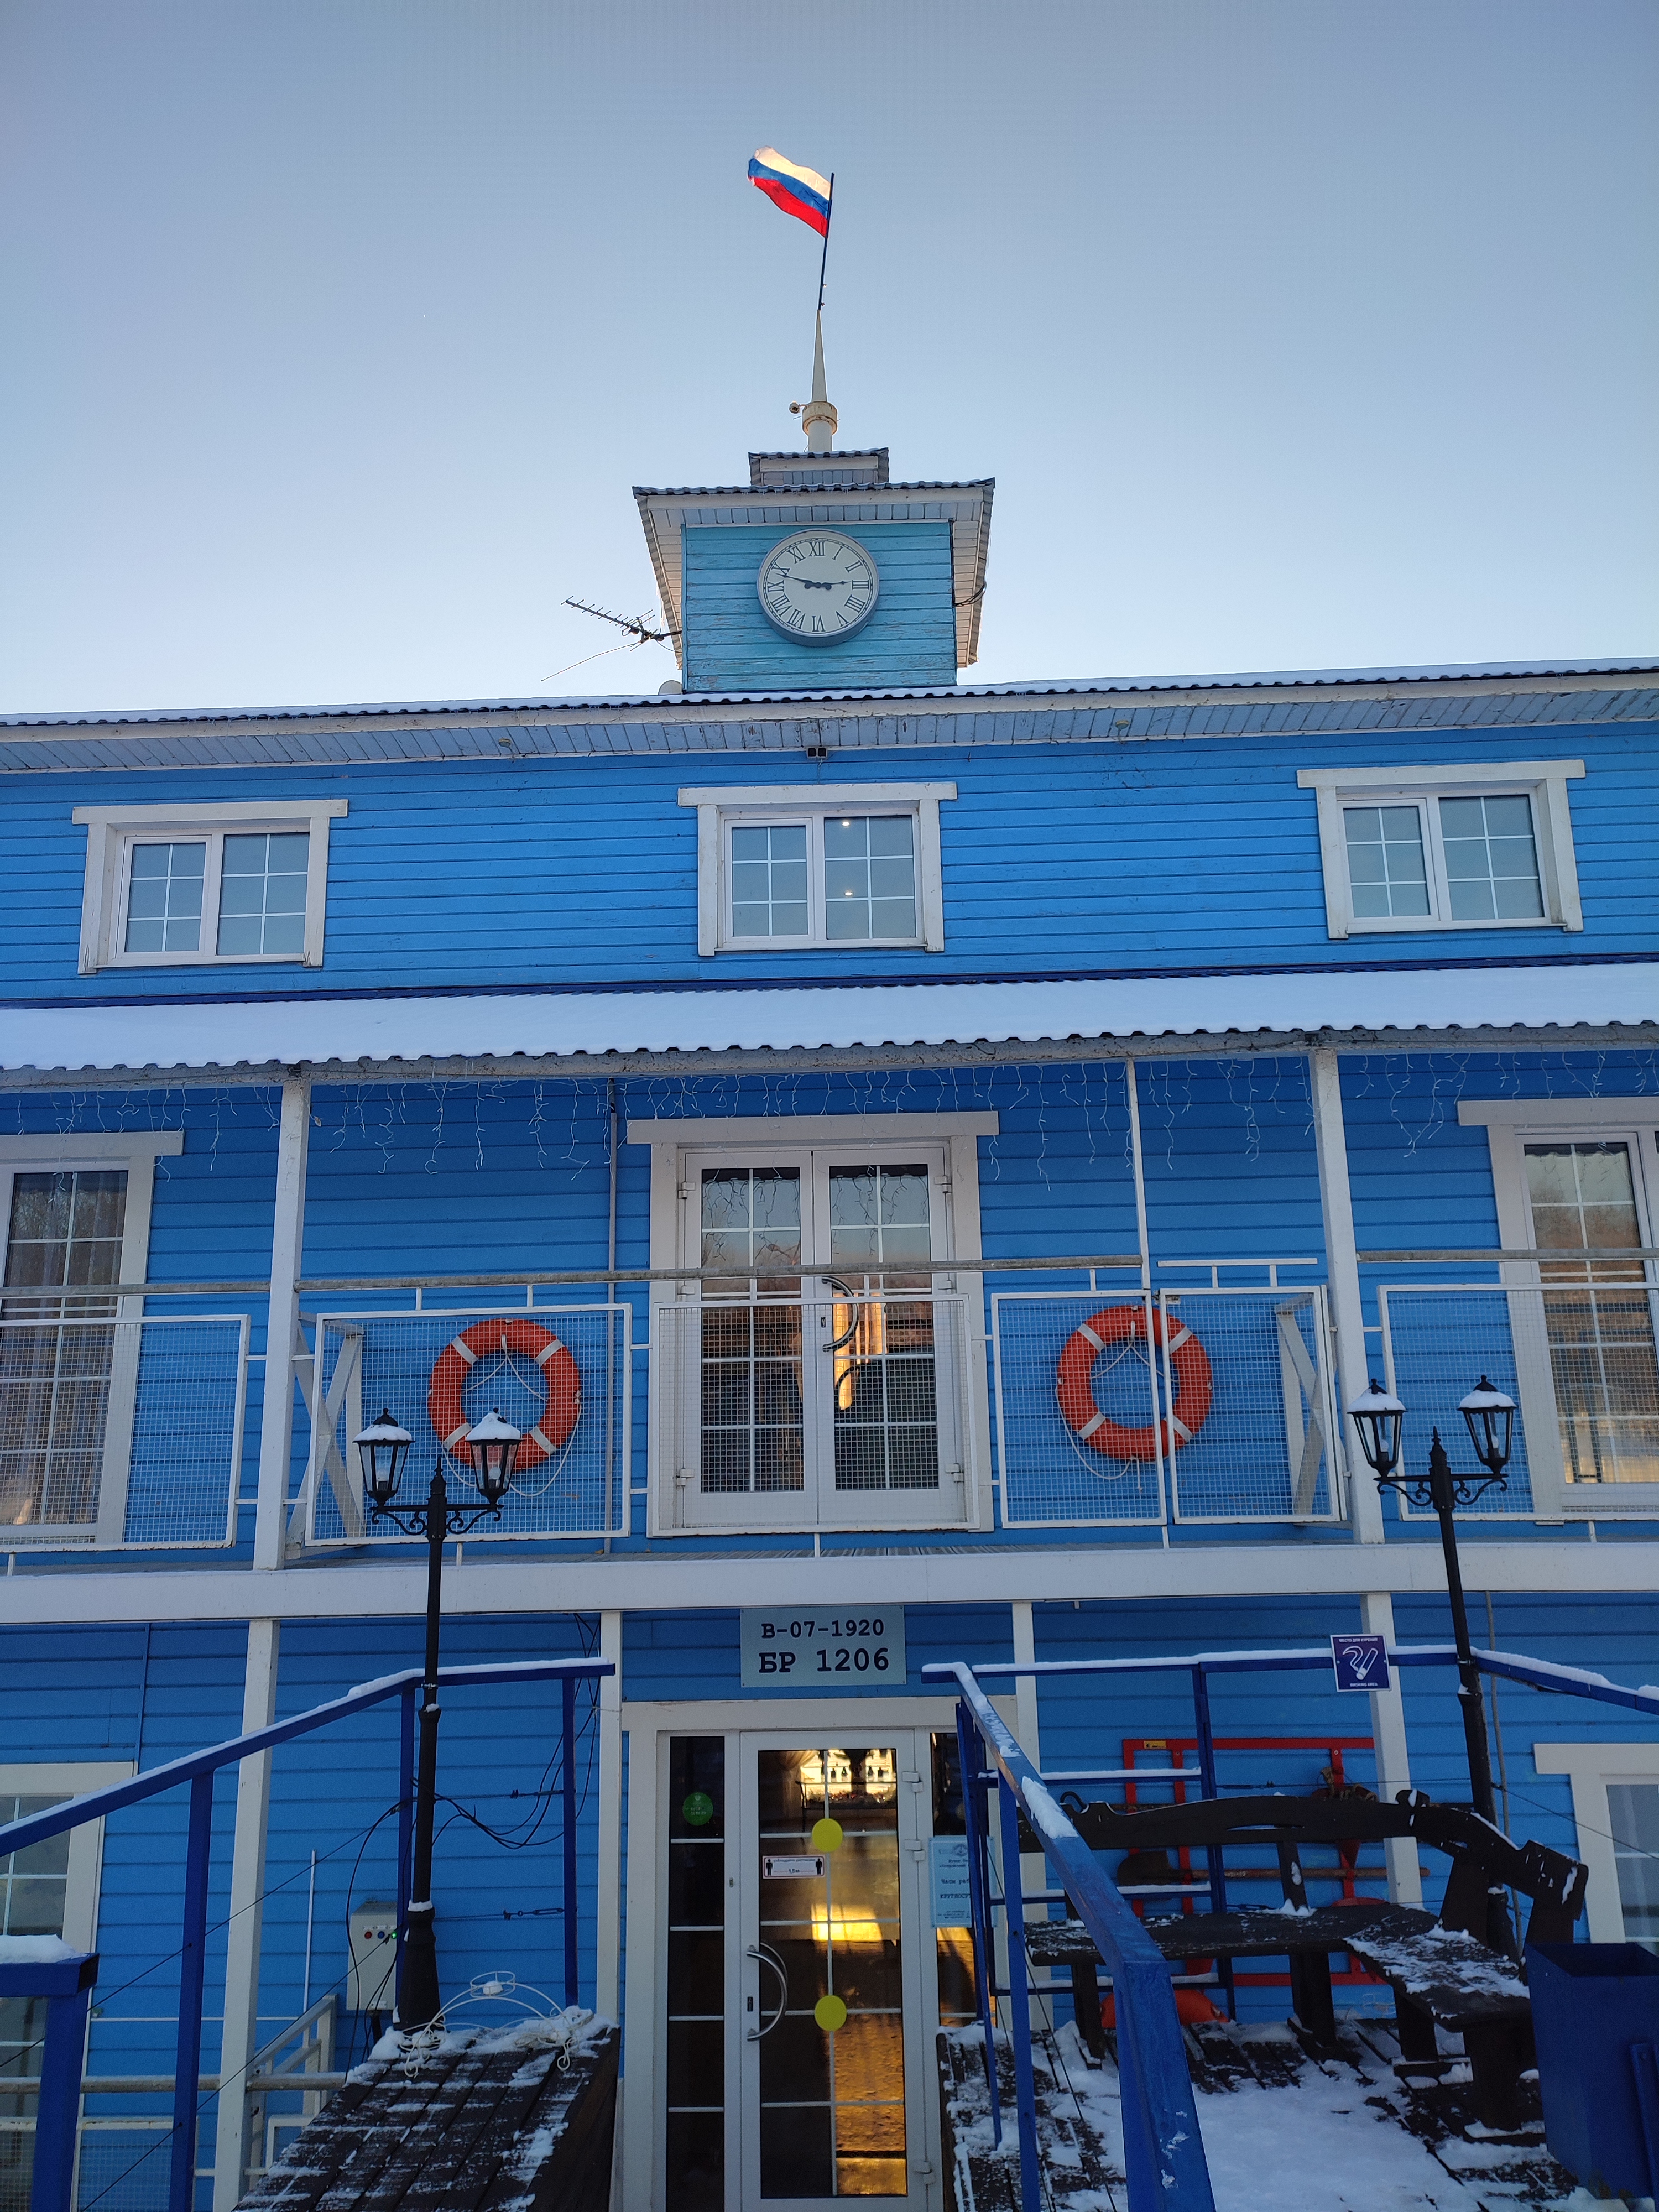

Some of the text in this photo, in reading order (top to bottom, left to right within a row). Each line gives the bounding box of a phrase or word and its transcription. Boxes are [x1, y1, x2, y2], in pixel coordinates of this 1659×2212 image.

[786, 545, 806, 564] XI
[808, 541, 826, 556] XII
[767, 580, 785, 592] IX
[852, 580, 869, 590] III
[761, 1619, 884, 1639] В-07-1920
[758, 1647, 889, 1673] БР 1206
